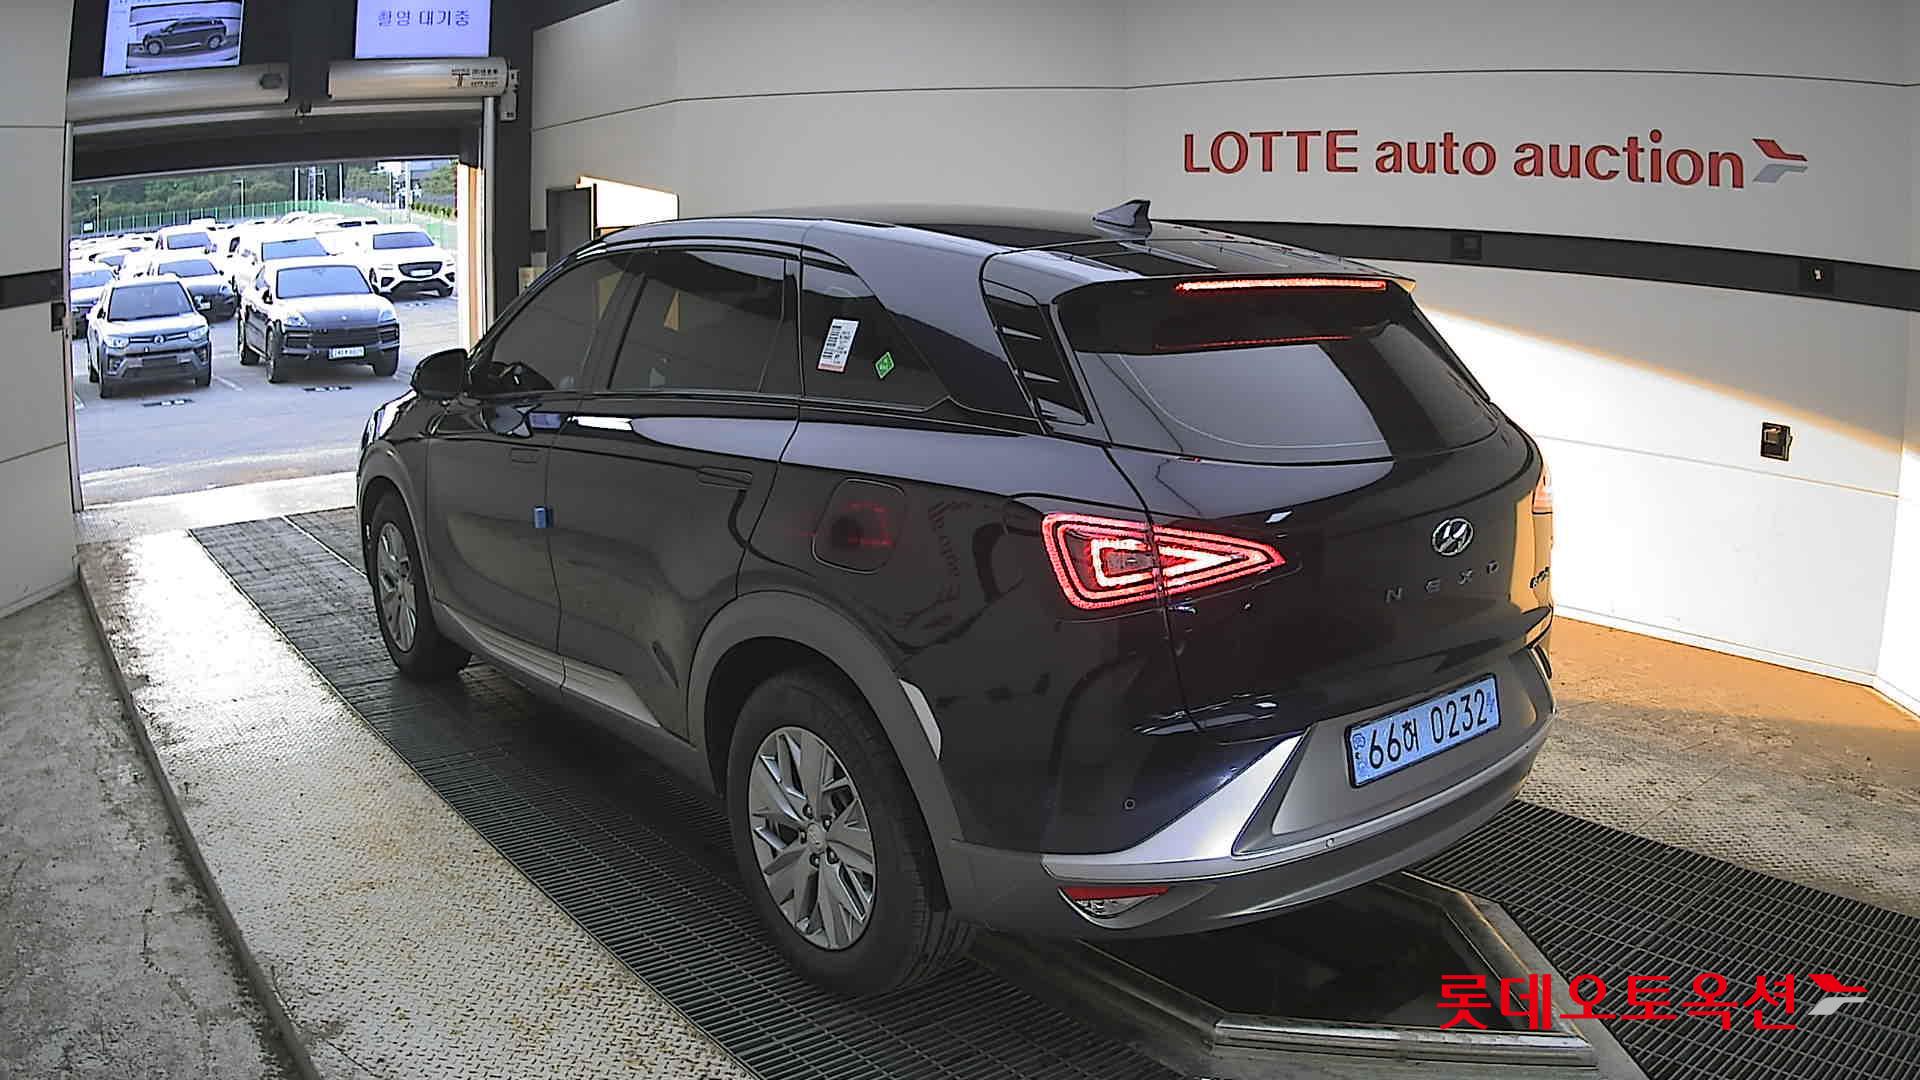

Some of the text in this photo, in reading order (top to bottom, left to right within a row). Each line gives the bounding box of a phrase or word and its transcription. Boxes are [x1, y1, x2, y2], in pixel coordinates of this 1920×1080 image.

[1184, 129, 1744, 188] LOTTE auto auction
[1385, 560, 1499, 603] NEXO
[1369, 689, 1487, 769] 66허 0232
